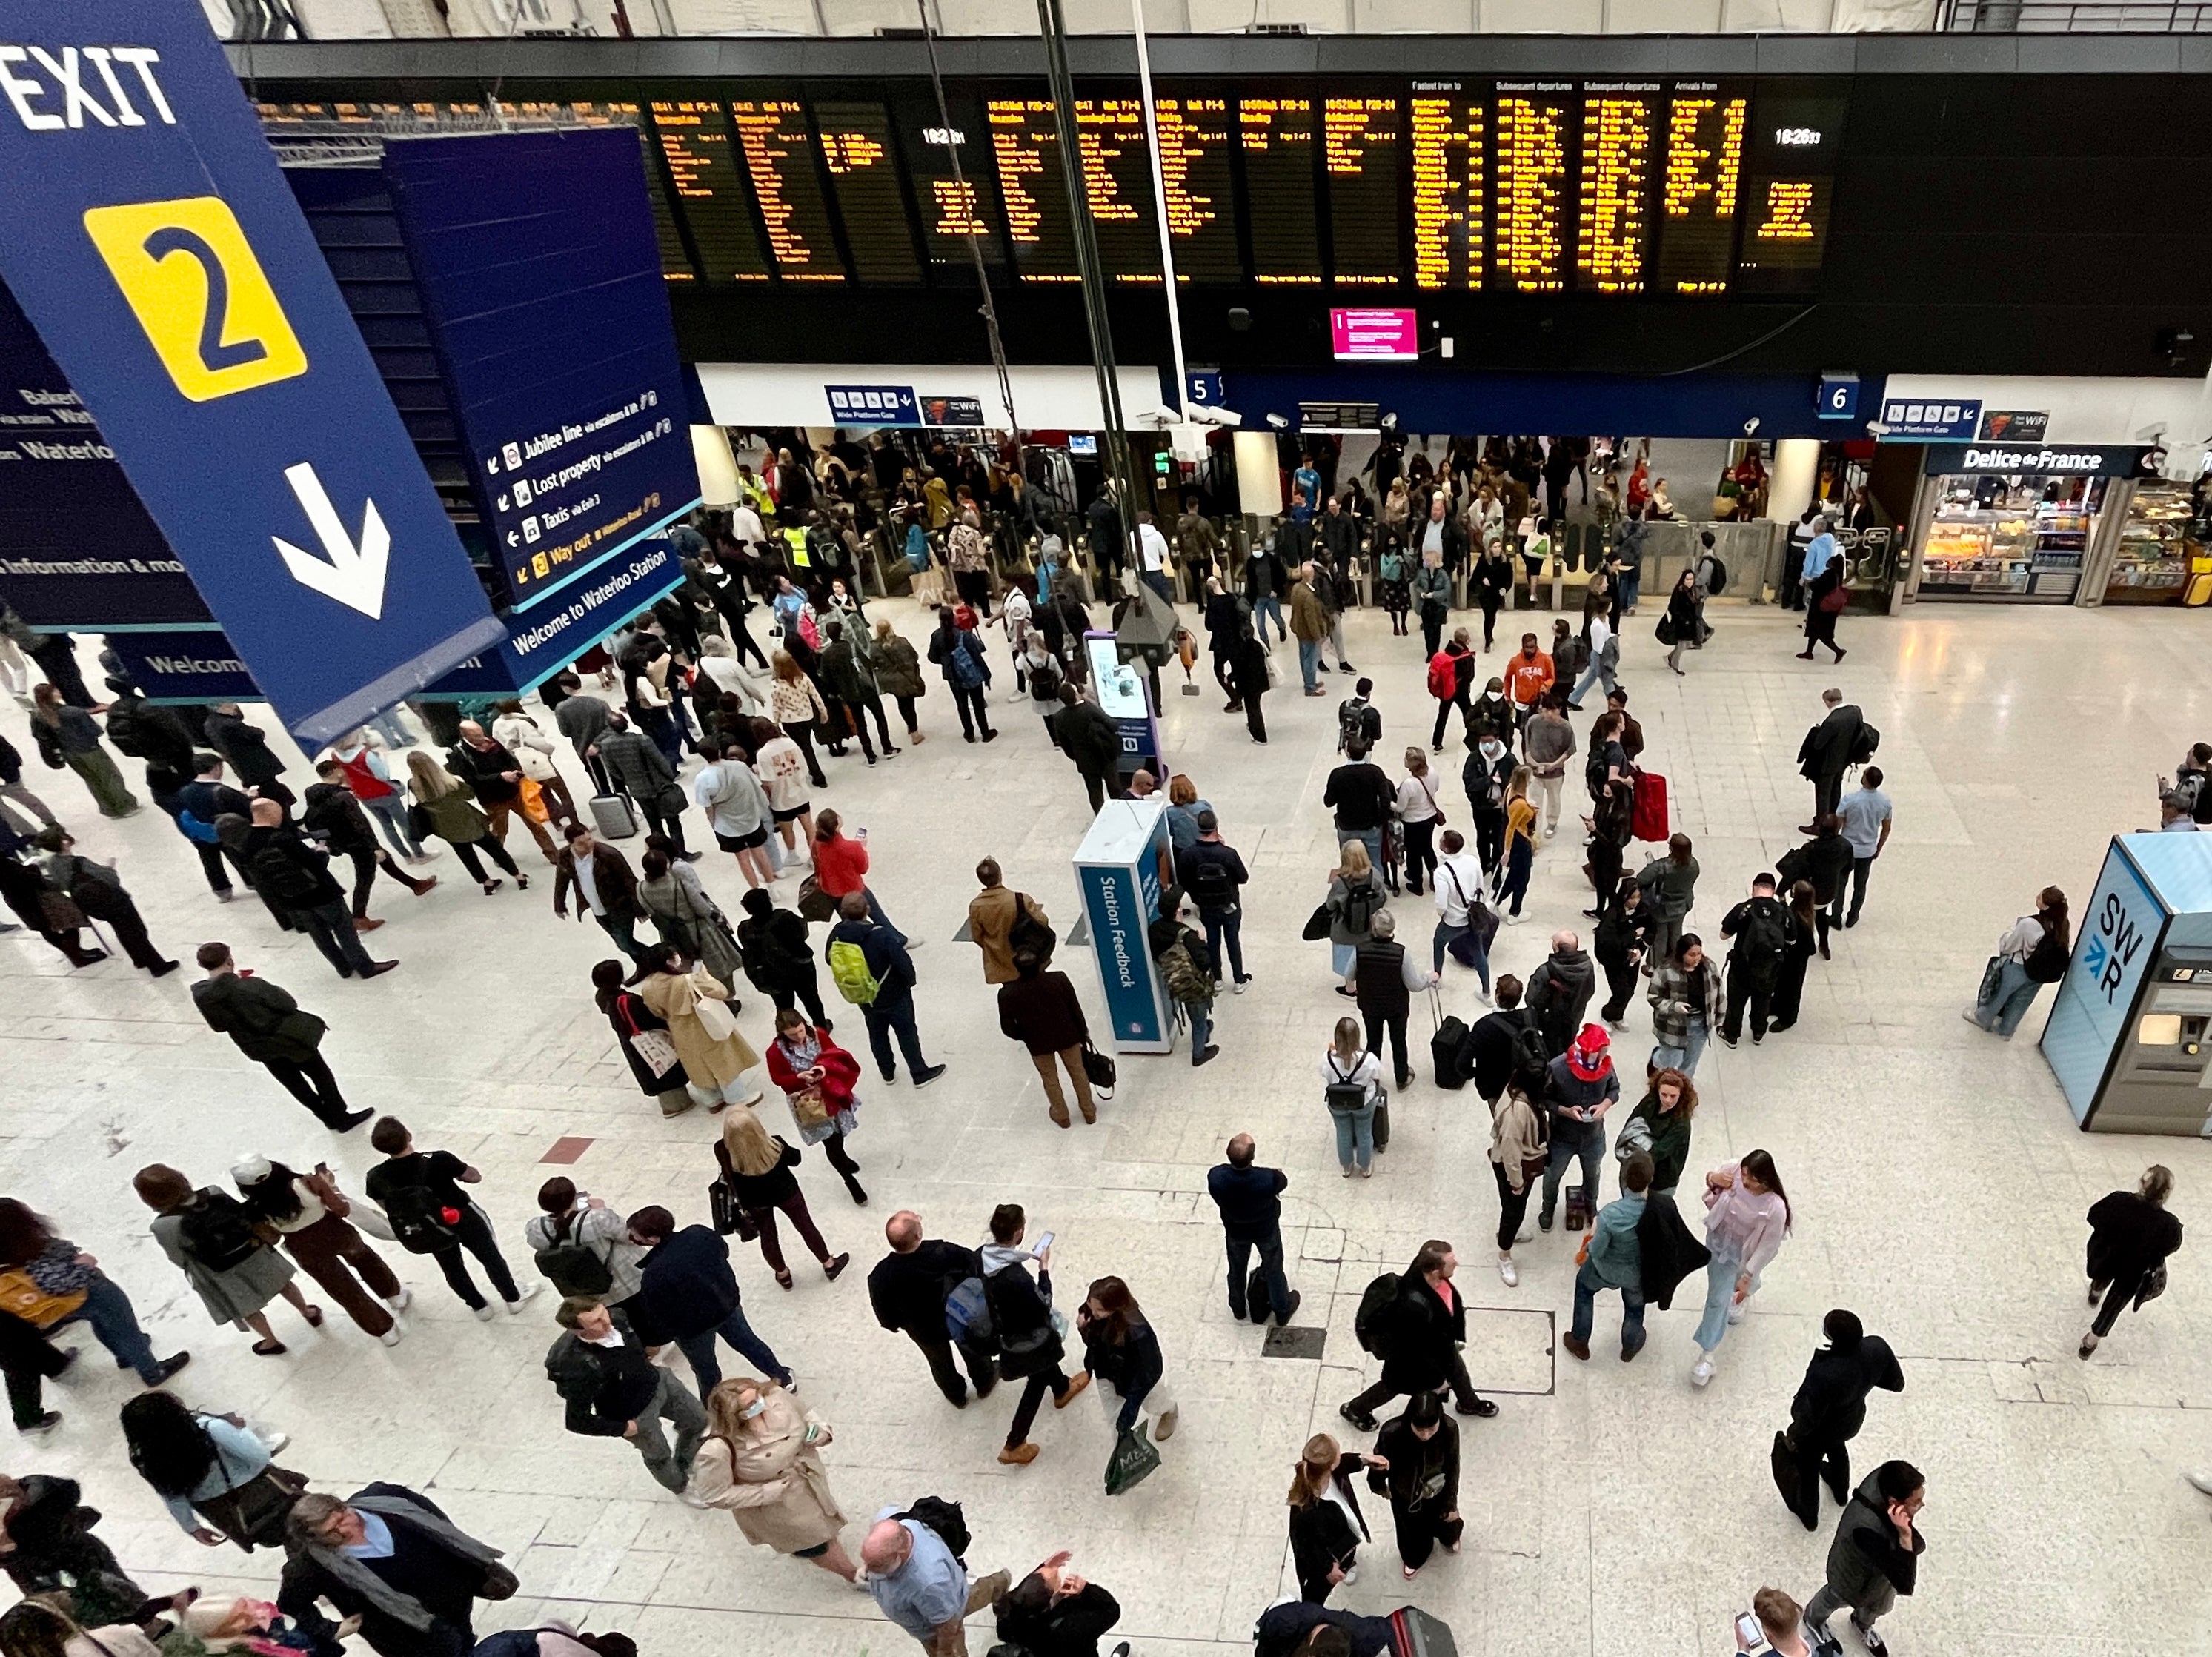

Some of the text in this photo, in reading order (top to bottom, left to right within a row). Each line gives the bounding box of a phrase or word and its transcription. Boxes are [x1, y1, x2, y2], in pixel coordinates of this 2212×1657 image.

[0, 46, 176, 130] EXIT
[1438, 82, 1452, 90] train
[1454, 82, 1461, 90] to
[1496, 81, 1572, 91] Subsequent departures
[1584, 82, 1661, 92] Subsequent departures
[1675, 82, 1718, 90] Arrivals from
[143, 226, 268, 372] 2
[1194, 379, 1207, 399] 5
[1833, 388, 1847, 409] 6
[881, 411, 896, 419] Gate
[959, 402, 981, 411] WiFi
[1933, 425, 1949, 434] Gate
[2025, 416, 2047, 425] WiFi
[16, 440, 116, 459] Waterlo
[524, 433, 563, 459] Jubilee
[561, 425, 583, 442] line
[1964, 449, 2102, 469] Delice de France
[532, 473, 559, 495] Lost
[559, 454, 601, 487] property
[541, 507, 571, 530] Taxis
[549, 545, 573, 565] Way
[574, 533, 593, 552] out
[1, 557, 132, 574] Information
[130, 559, 150, 573] &
[512, 550, 668, 657] Welcome to Waterloo Station
[145, 655, 248, 673] Welcom
[1100, 877, 1135, 989] Station Feedback
